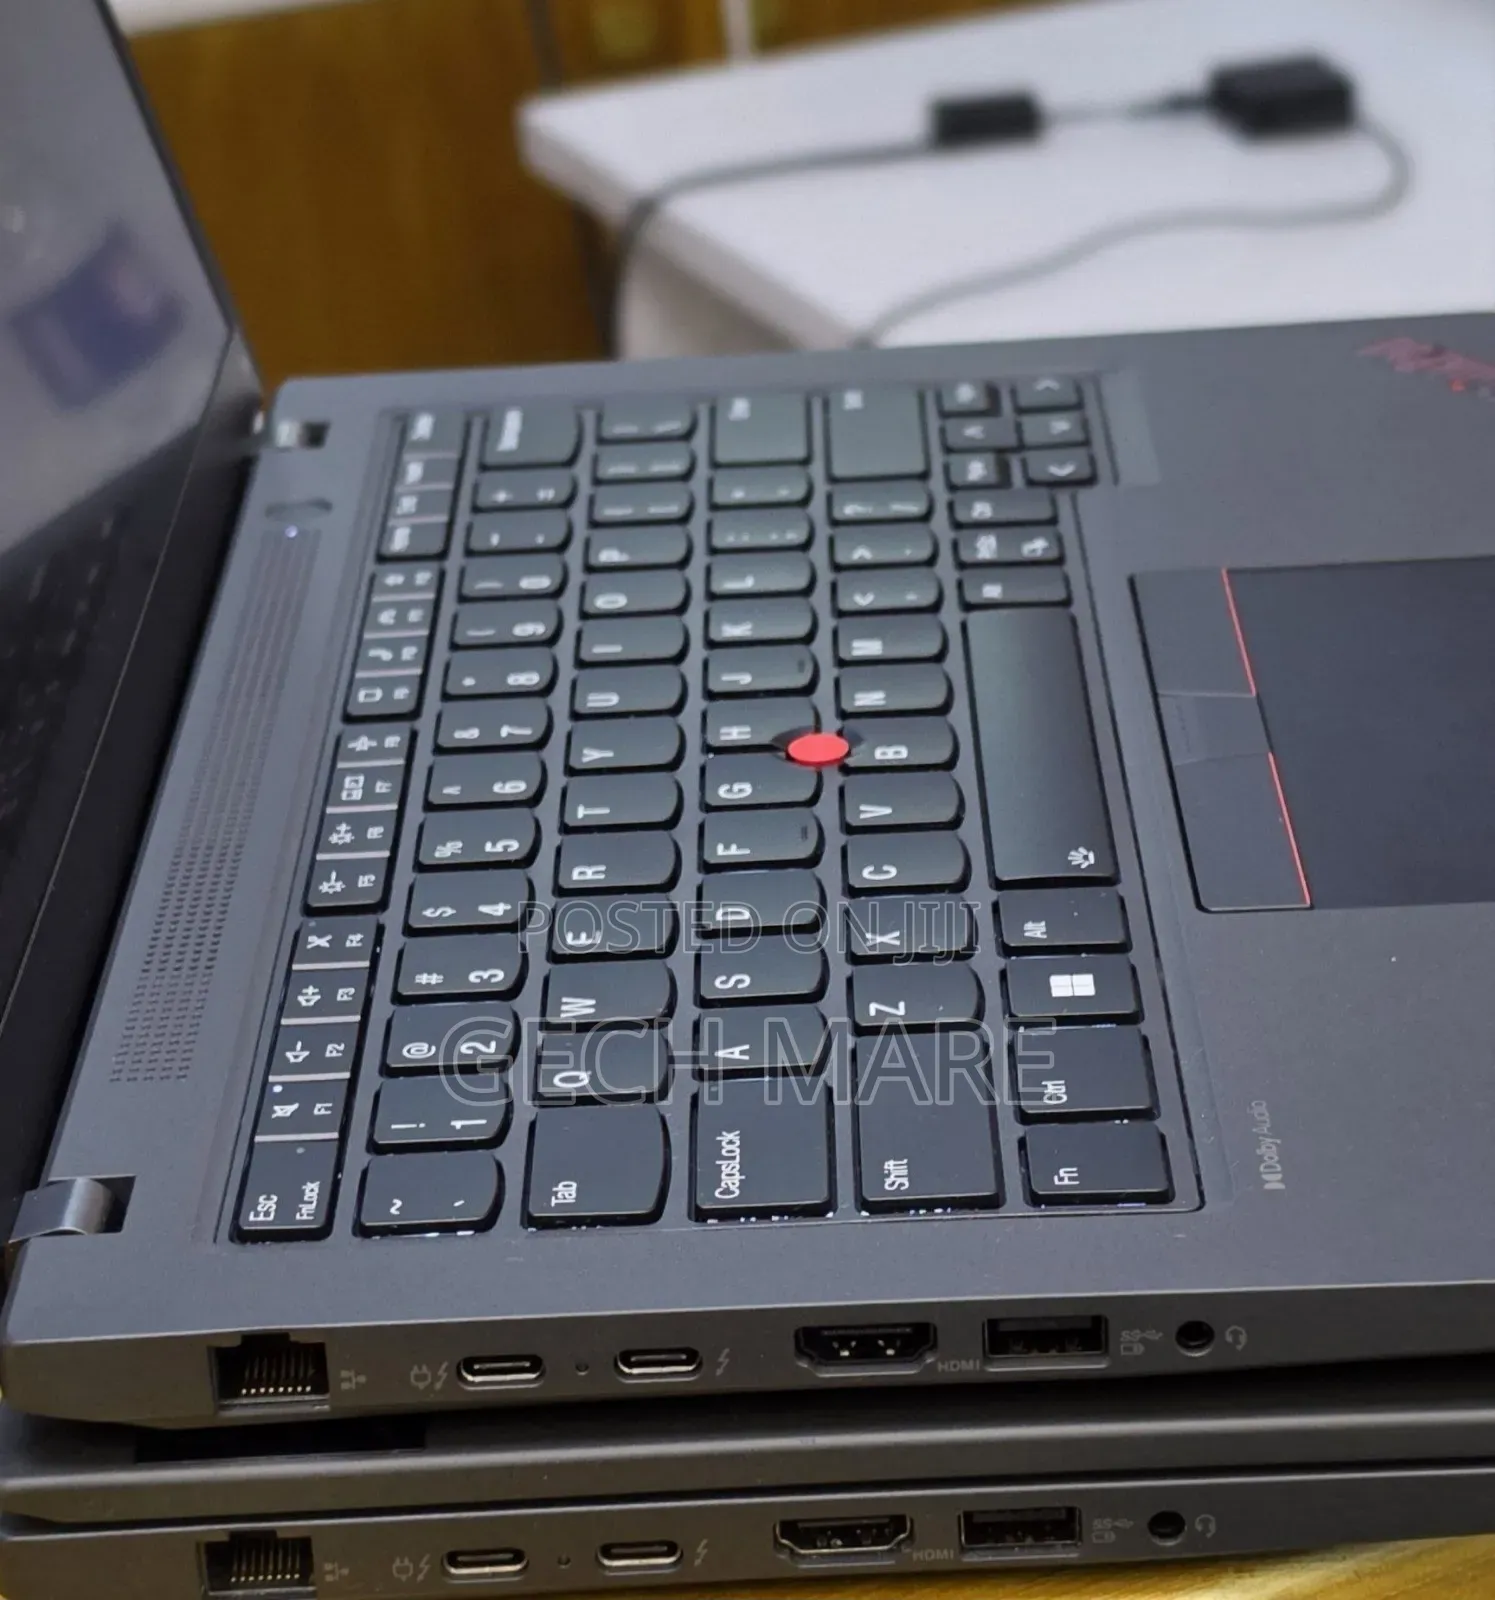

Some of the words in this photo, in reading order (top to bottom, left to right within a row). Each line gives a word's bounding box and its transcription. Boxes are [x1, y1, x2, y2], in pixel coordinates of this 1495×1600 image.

[723, 576, 754, 589] L
[595, 594, 627, 608] O
[513, 623, 545, 636] 9
[722, 624, 752, 636] K
[507, 672, 539, 685] 8
[722, 674, 752, 684] J
[587, 693, 619, 706] U
[855, 691, 885, 706] N
[500, 726, 532, 737] 7
[720, 727, 751, 740] H
[582, 749, 614, 762] Y
[875, 746, 908, 759] B
[493, 781, 526, 793] 6
[718, 783, 752, 798] G
[578, 805, 610, 818] T
[860, 805, 892, 818] V
[485, 840, 519, 852] 5
[717, 843, 750, 855] F
[572, 866, 606, 880] R
[862, 866, 897, 880] C
[358, 875, 375, 887] F5
[423, 907, 456, 917] $
[479, 903, 511, 916] 4
[715, 907, 751, 921] D
[1024, 920, 1046, 939] Alt
[346, 934, 363, 947] F4
[566, 930, 600, 945] E
[866, 930, 900, 947] X
[416, 973, 443, 984] #
[469, 969, 504, 982] 3
[715, 975, 750, 988] S
[337, 988, 355, 1001] F3
[560, 998, 596, 1018] W
[869, 1002, 905, 1016] Z
[326, 1044, 344, 1057] F2
[402, 1043, 436, 1058] @
[460, 1040, 497, 1054] 2
[714, 1043, 750, 1061] A
[553, 1069, 591, 1088] Q
[1043, 1079, 1068, 1105] Ctrl
[314, 1103, 332, 1115] F1
[451, 1120, 487, 1129] 1
[1256, 1136, 1282, 1172] Dolby
[715, 1130, 743, 1199] CapsLock
[884, 1159, 909, 1190] Shift
[1054, 1168, 1079, 1185] Fn
[551, 1181, 577, 1207] Tab
[296, 1182, 320, 1220] FnLock
[249, 1195, 277, 1221] Esc
[937, 1358, 981, 1373] HDMI
[912, 1548, 955, 1561] HDMI
